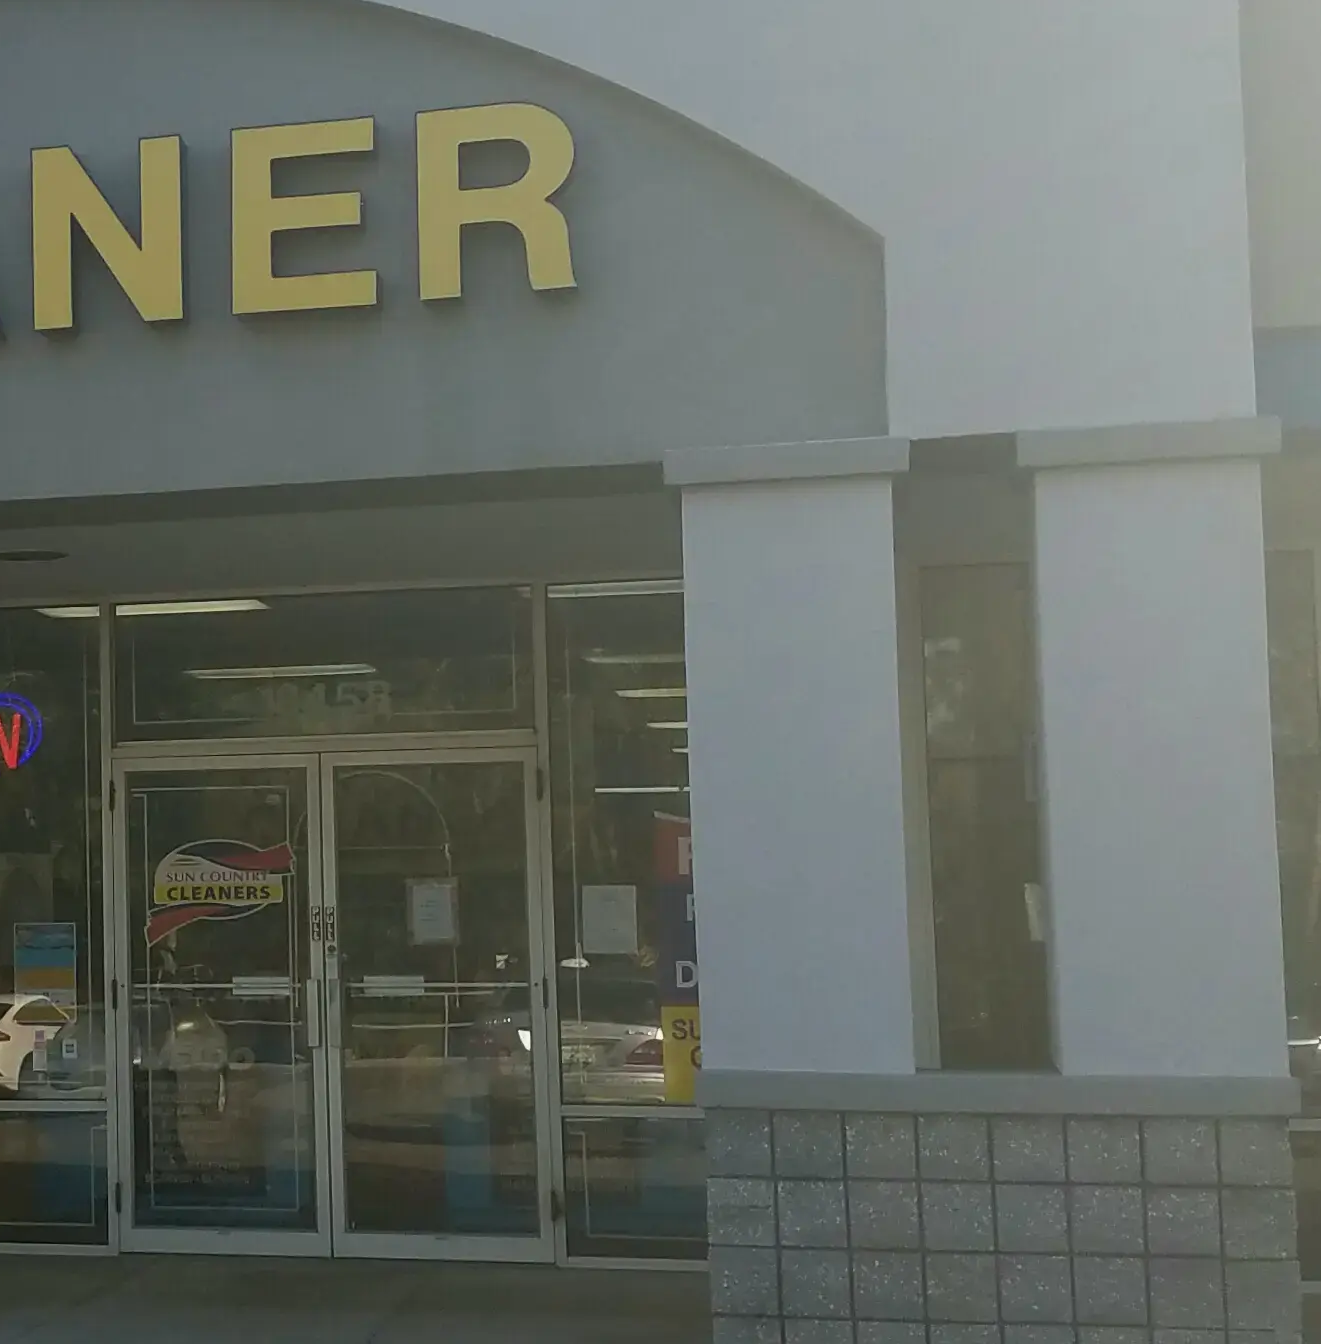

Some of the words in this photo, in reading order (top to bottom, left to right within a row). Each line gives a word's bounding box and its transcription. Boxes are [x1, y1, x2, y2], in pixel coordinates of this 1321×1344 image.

[166, 871, 196, 883] SUN
[200, 869, 268, 883] COUNTRY
[166, 885, 271, 902] CLEANERS
